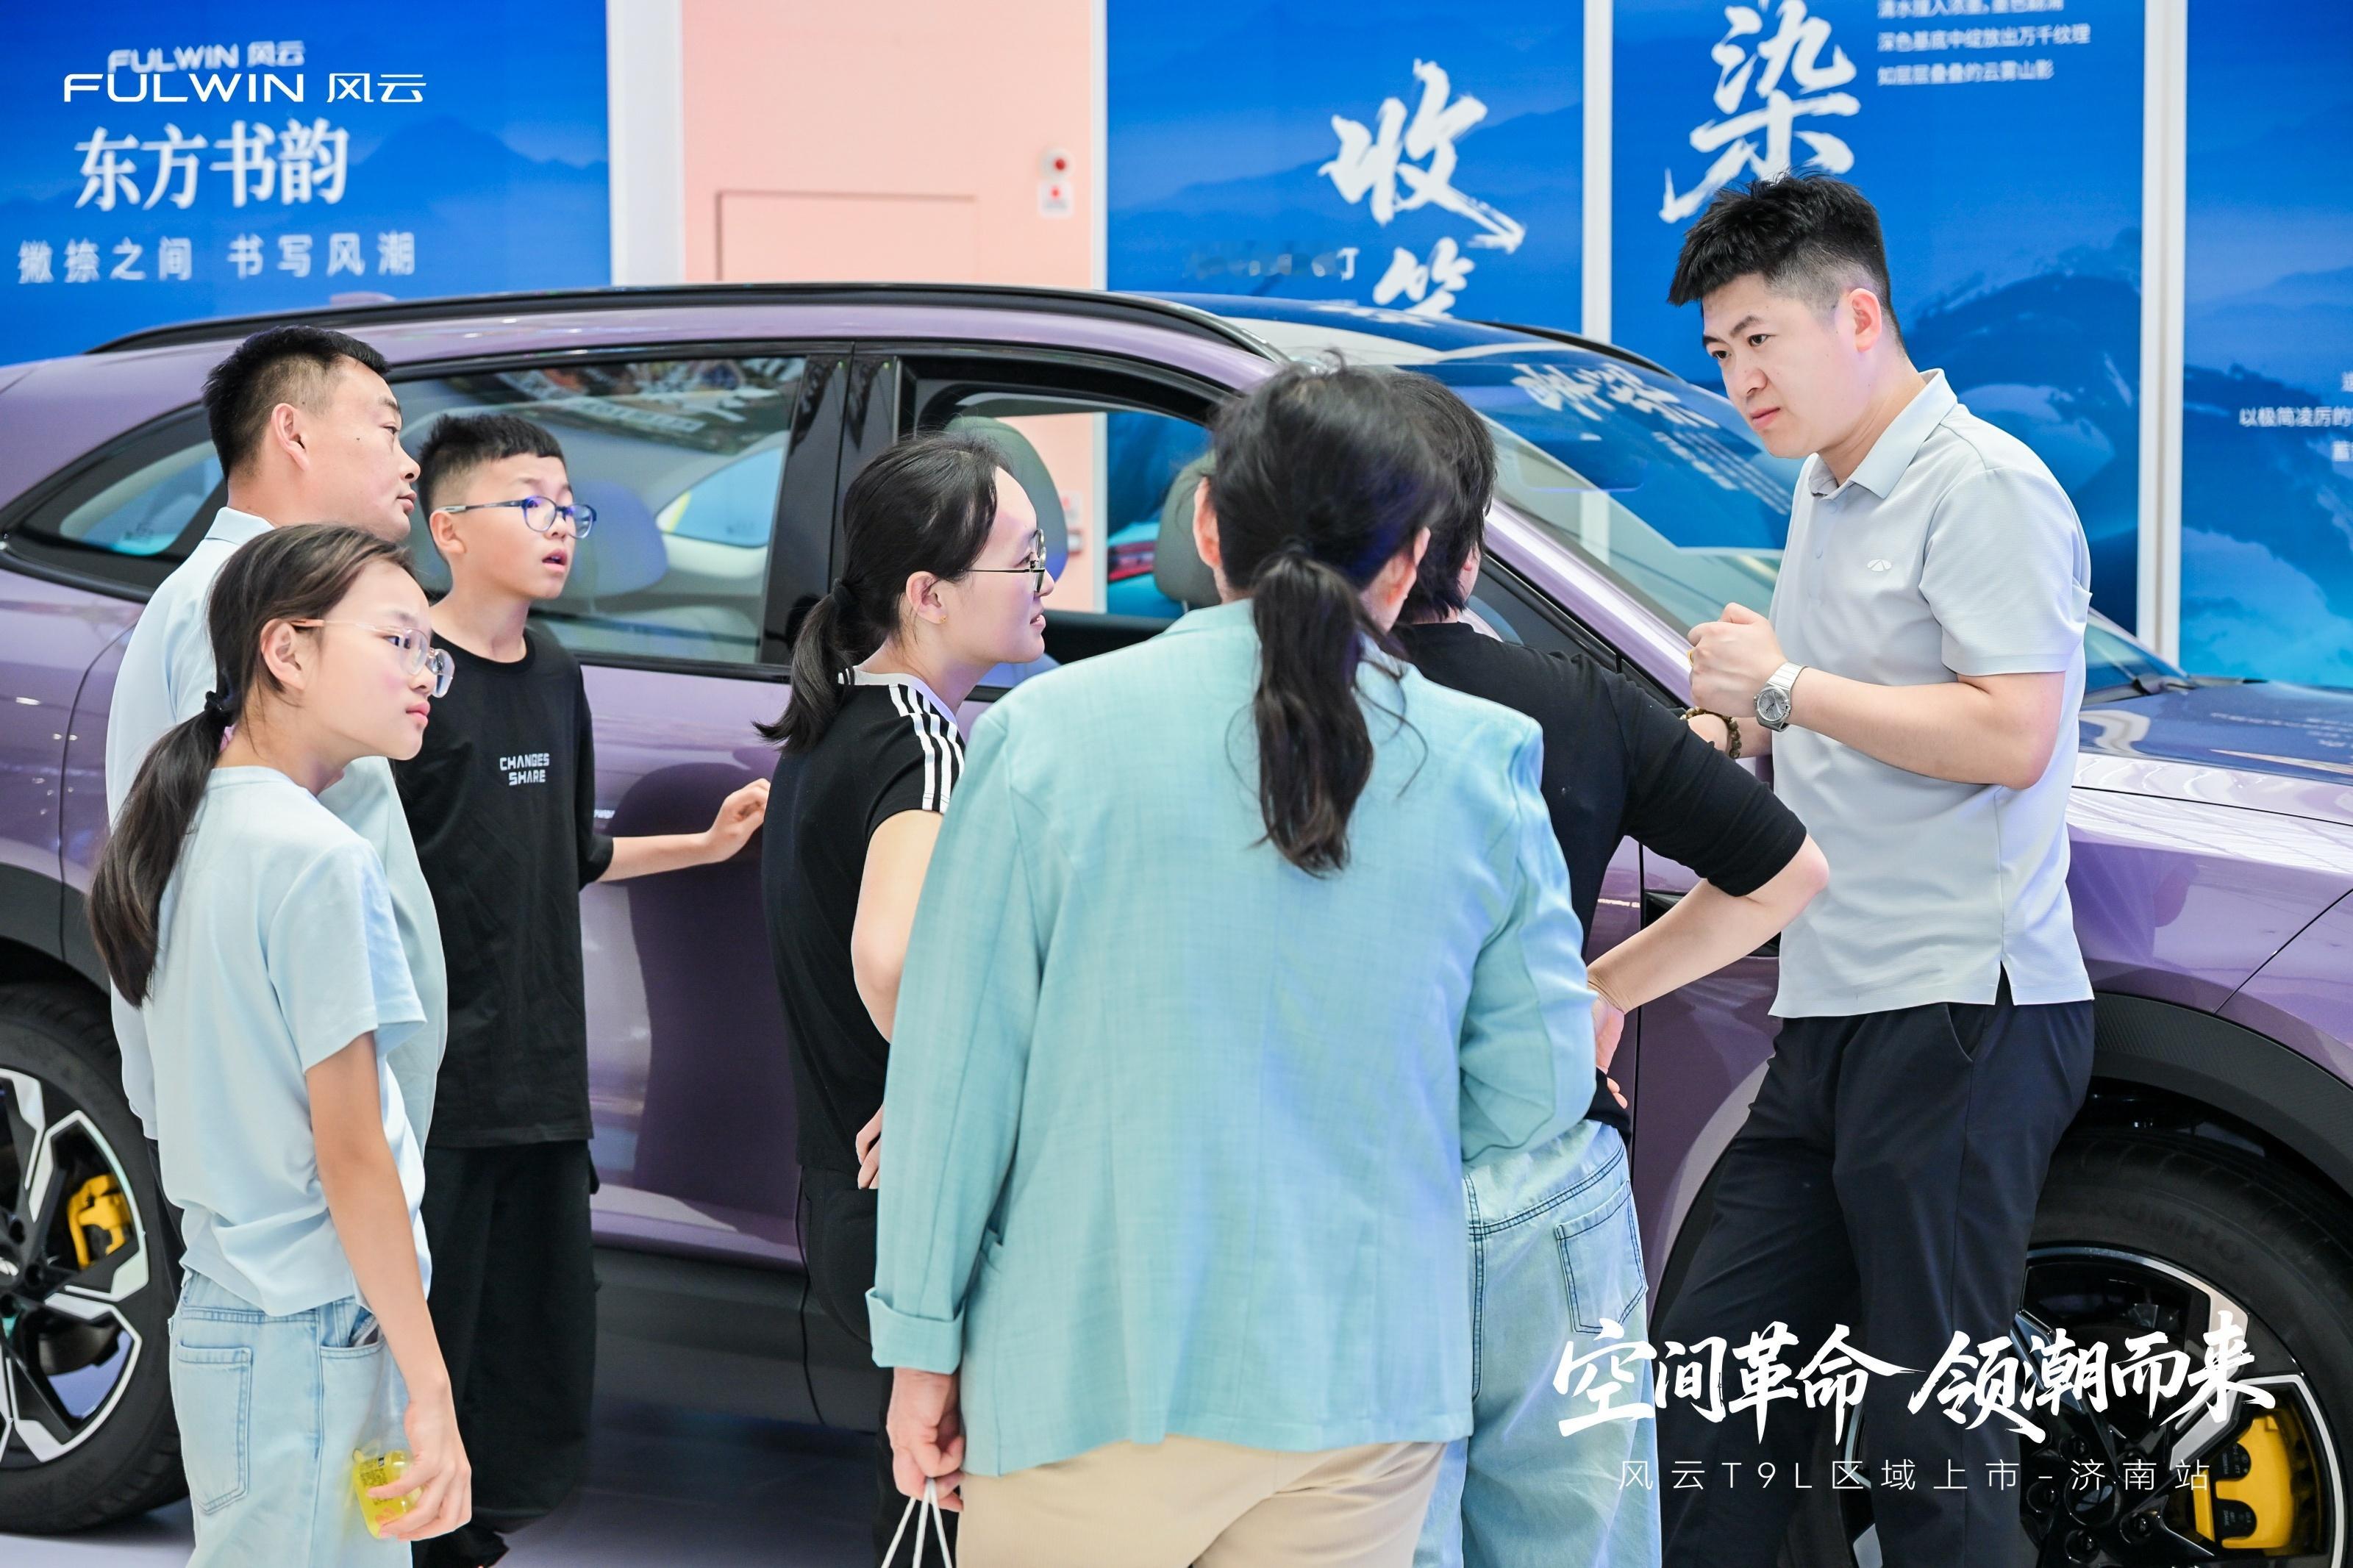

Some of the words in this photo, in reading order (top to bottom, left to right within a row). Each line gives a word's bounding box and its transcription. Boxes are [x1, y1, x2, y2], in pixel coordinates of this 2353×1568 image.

[107, 43, 240, 74] FULWIN
[246, 40, 306, 68] 风云
[1660, 0, 1861, 222] 染
[74, 117, 351, 212] 东方书韵
[17, 236, 193, 285] 撇捺之间
[226, 229, 416, 279] 书写风潮
[499, 752, 550, 771] CHANGES
[508, 769, 546, 786] SHARE
